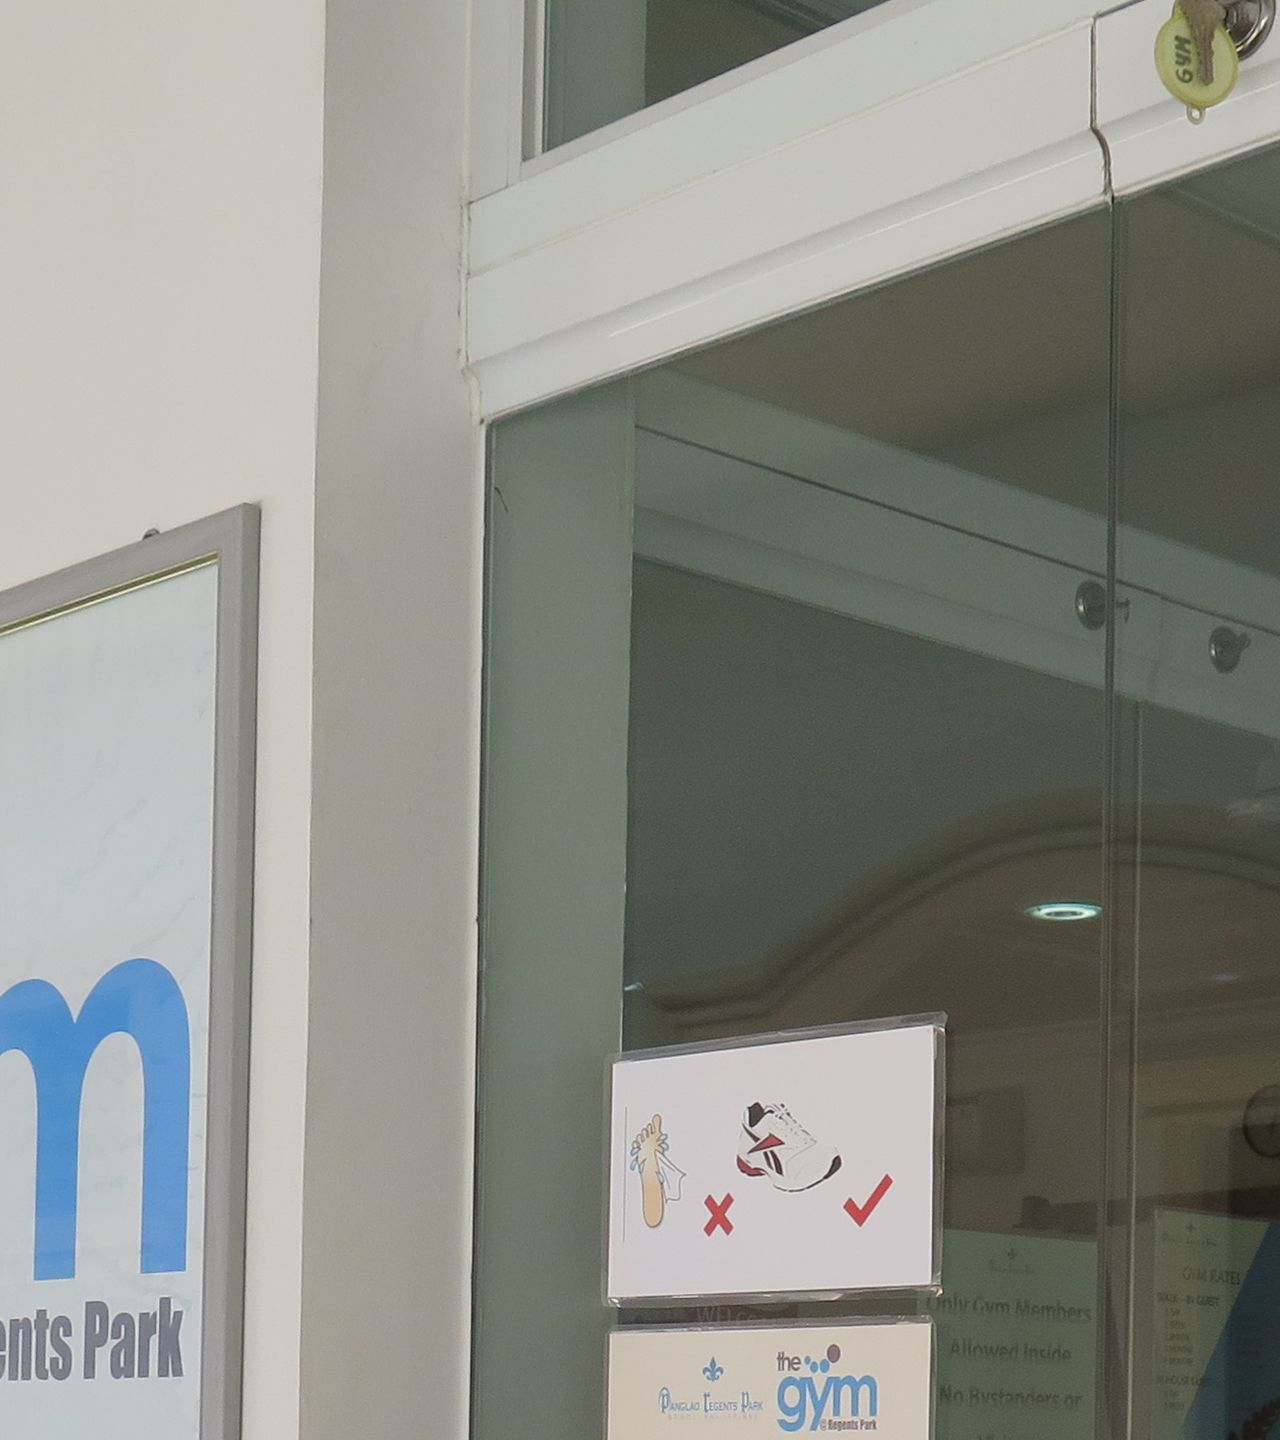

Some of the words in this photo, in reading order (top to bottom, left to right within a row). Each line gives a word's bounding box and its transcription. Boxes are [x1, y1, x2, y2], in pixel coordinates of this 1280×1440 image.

[82, 1297, 185, 1380] Park
[777, 1352, 801, 1371] the
[777, 1375, 878, 1432] gym
[860, 1418, 878, 1431] Park
